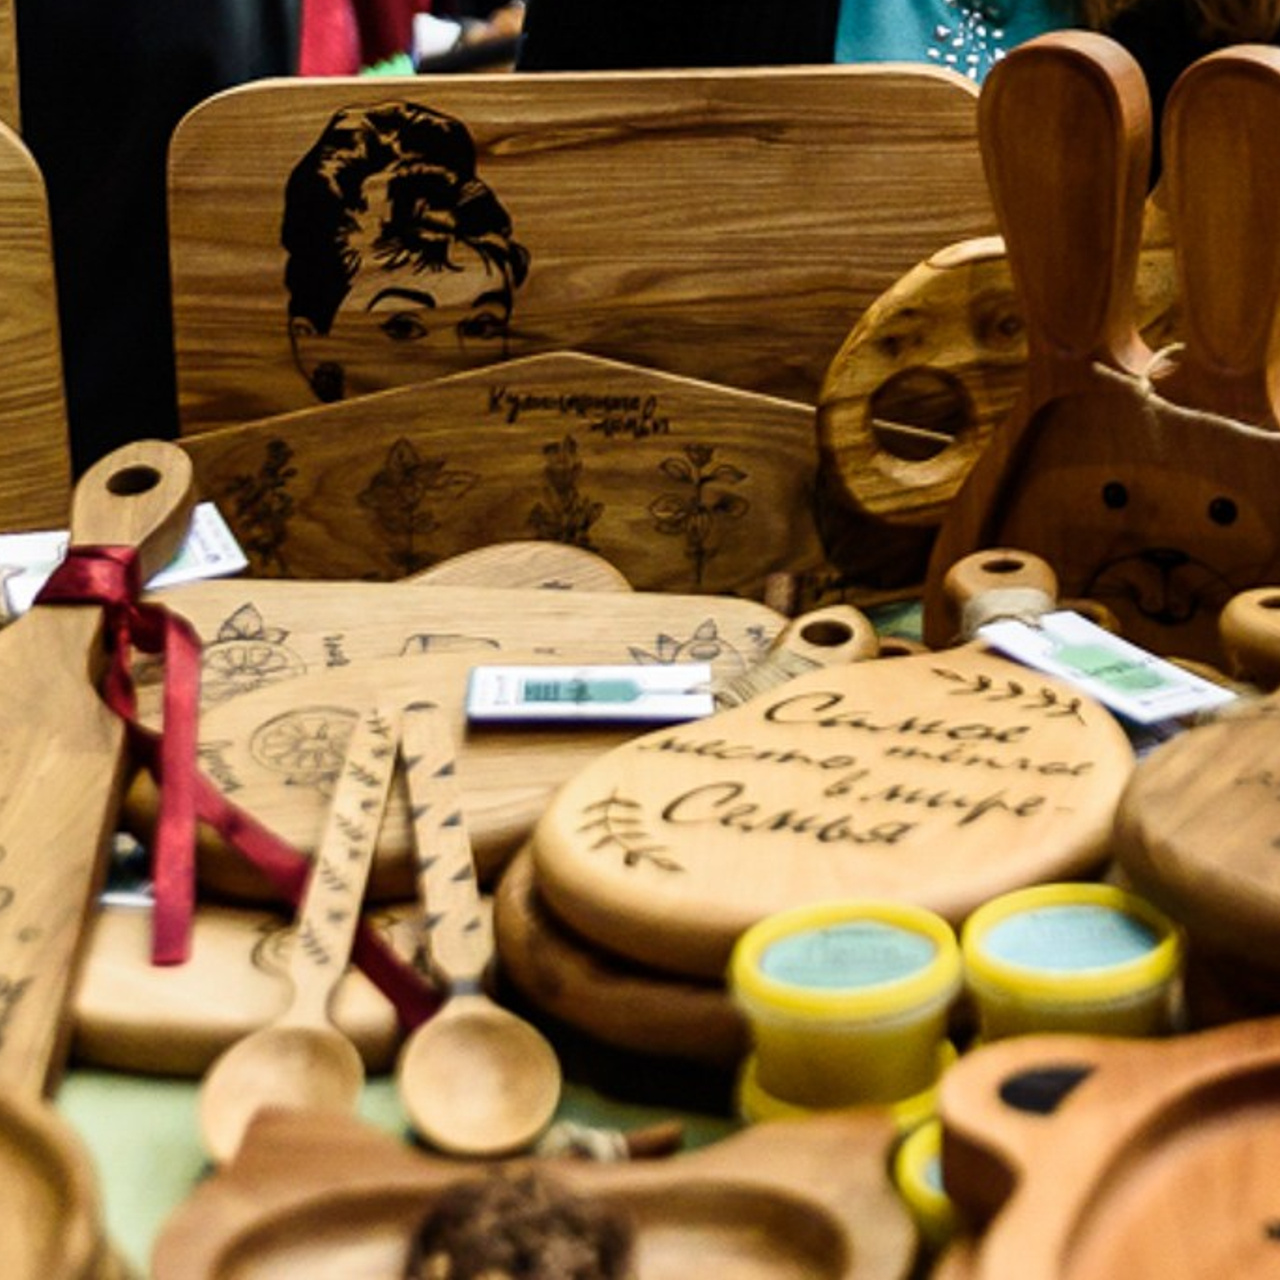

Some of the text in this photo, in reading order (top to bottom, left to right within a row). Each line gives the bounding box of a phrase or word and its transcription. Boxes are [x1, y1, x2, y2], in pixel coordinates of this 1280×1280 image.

[763, 691, 1031, 745] Самое
[636, 736, 857, 771] место
[660, 781, 922, 844] Семья
